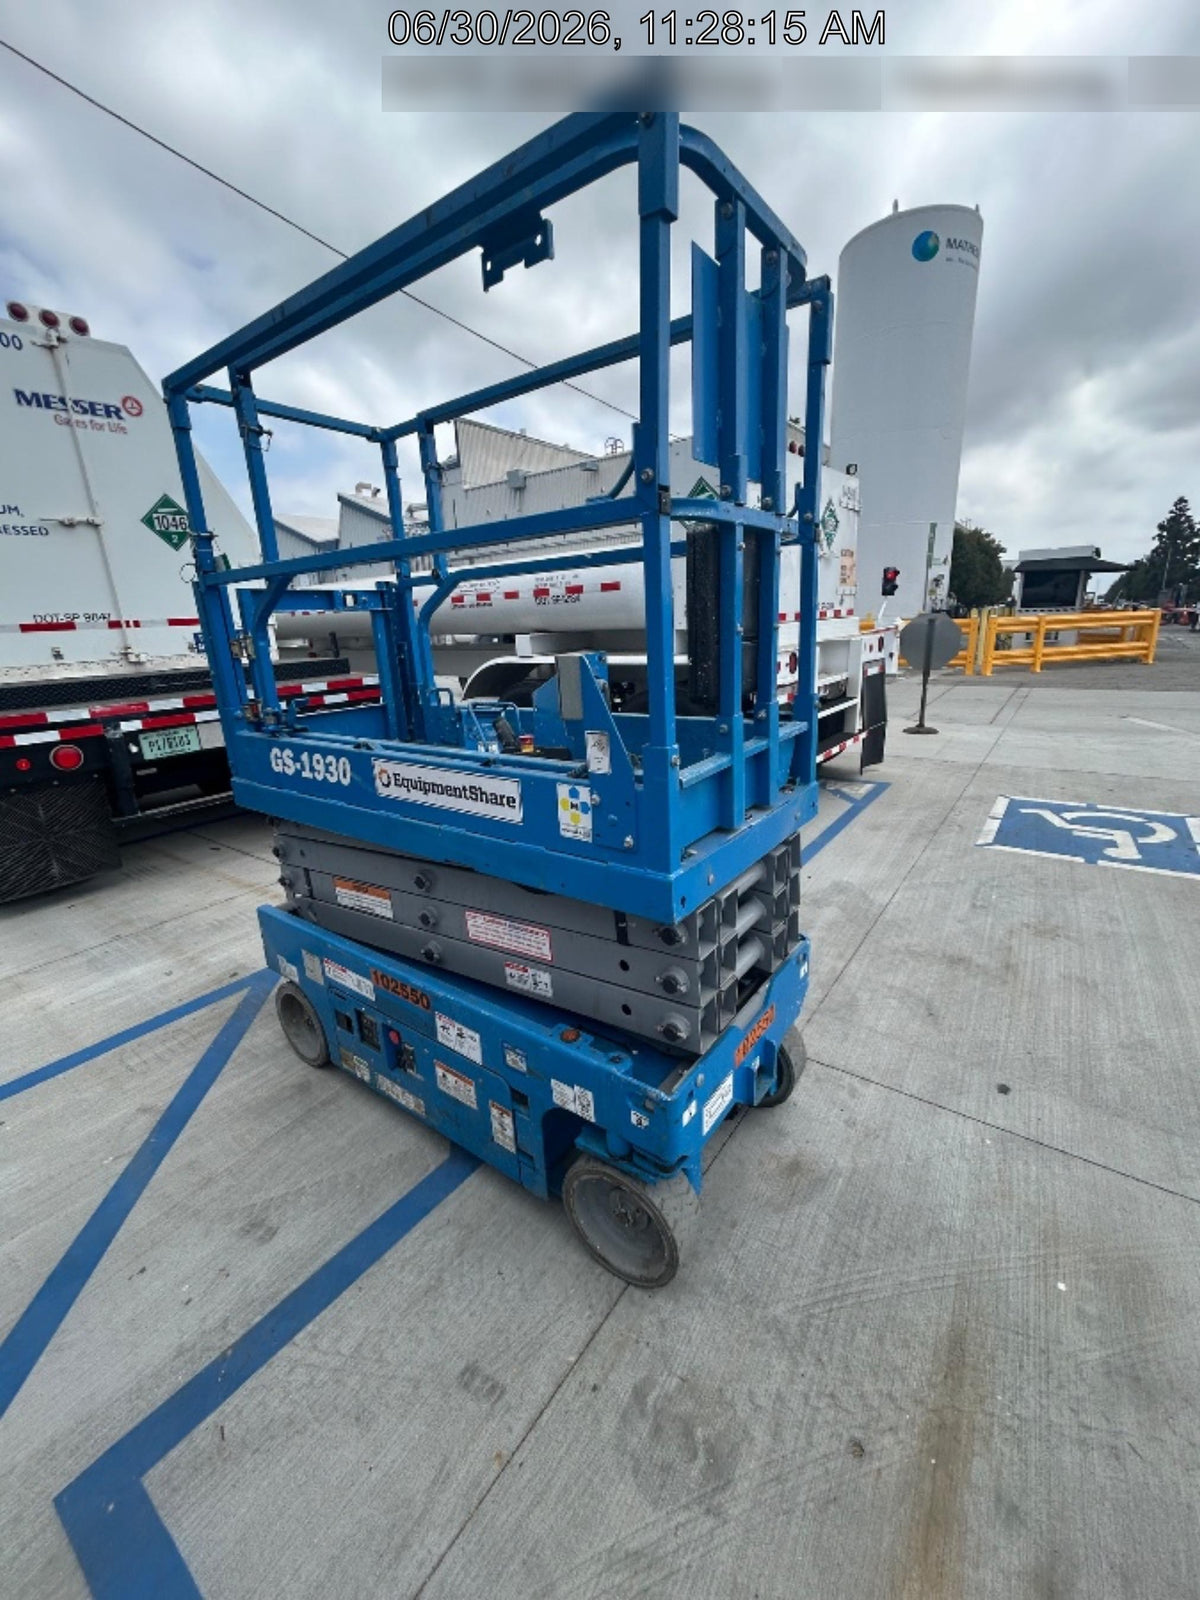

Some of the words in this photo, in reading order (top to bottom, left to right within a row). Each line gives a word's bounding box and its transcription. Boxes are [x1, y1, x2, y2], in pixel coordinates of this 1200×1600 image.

[154, 514, 188, 531] 1046
[171, 534, 179, 543] 2
[269, 747, 351, 787] GS-1930
[393, 771, 517, 810] EquipmentShare
